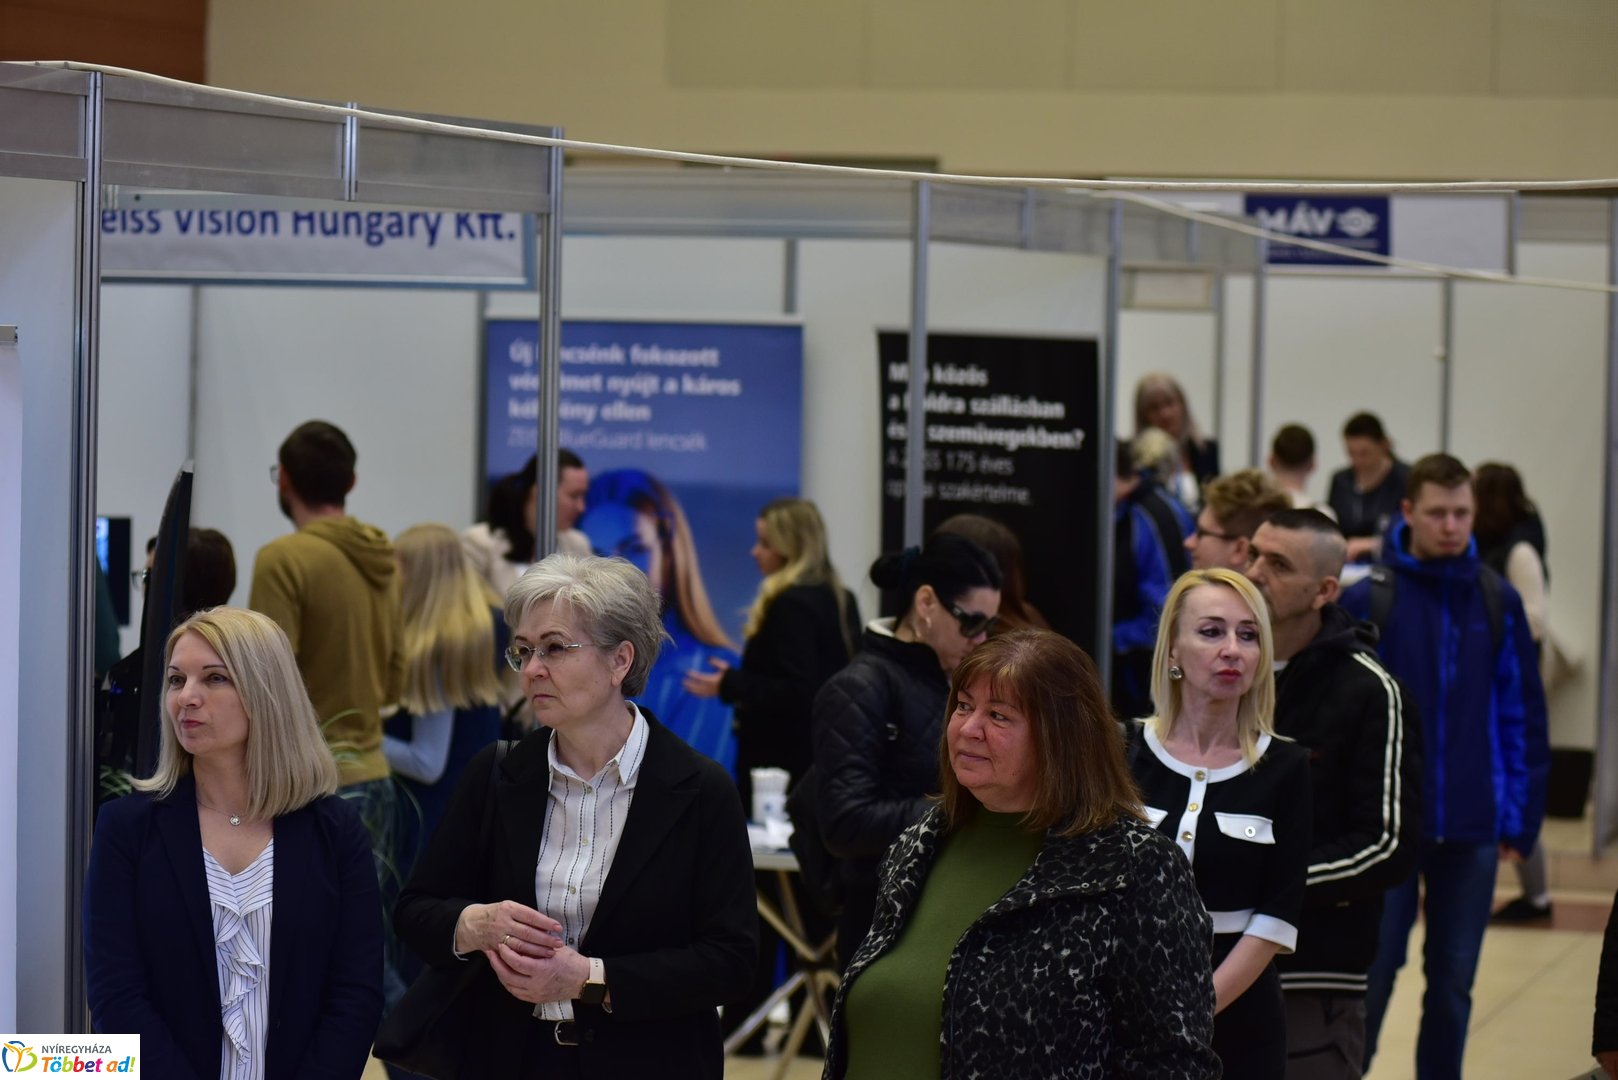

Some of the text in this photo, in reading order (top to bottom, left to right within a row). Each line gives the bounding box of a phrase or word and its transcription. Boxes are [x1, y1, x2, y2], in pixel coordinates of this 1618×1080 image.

[102, 210, 516, 247] eiss Vision Hungary Kft.
[1257, 201, 1335, 236] MÁV
[630, 343, 720, 367] fokozott
[605, 372, 660, 398] nyújt
[681, 374, 742, 397] káros
[600, 401, 652, 421] ellen
[969, 395, 1066, 418] szállásban
